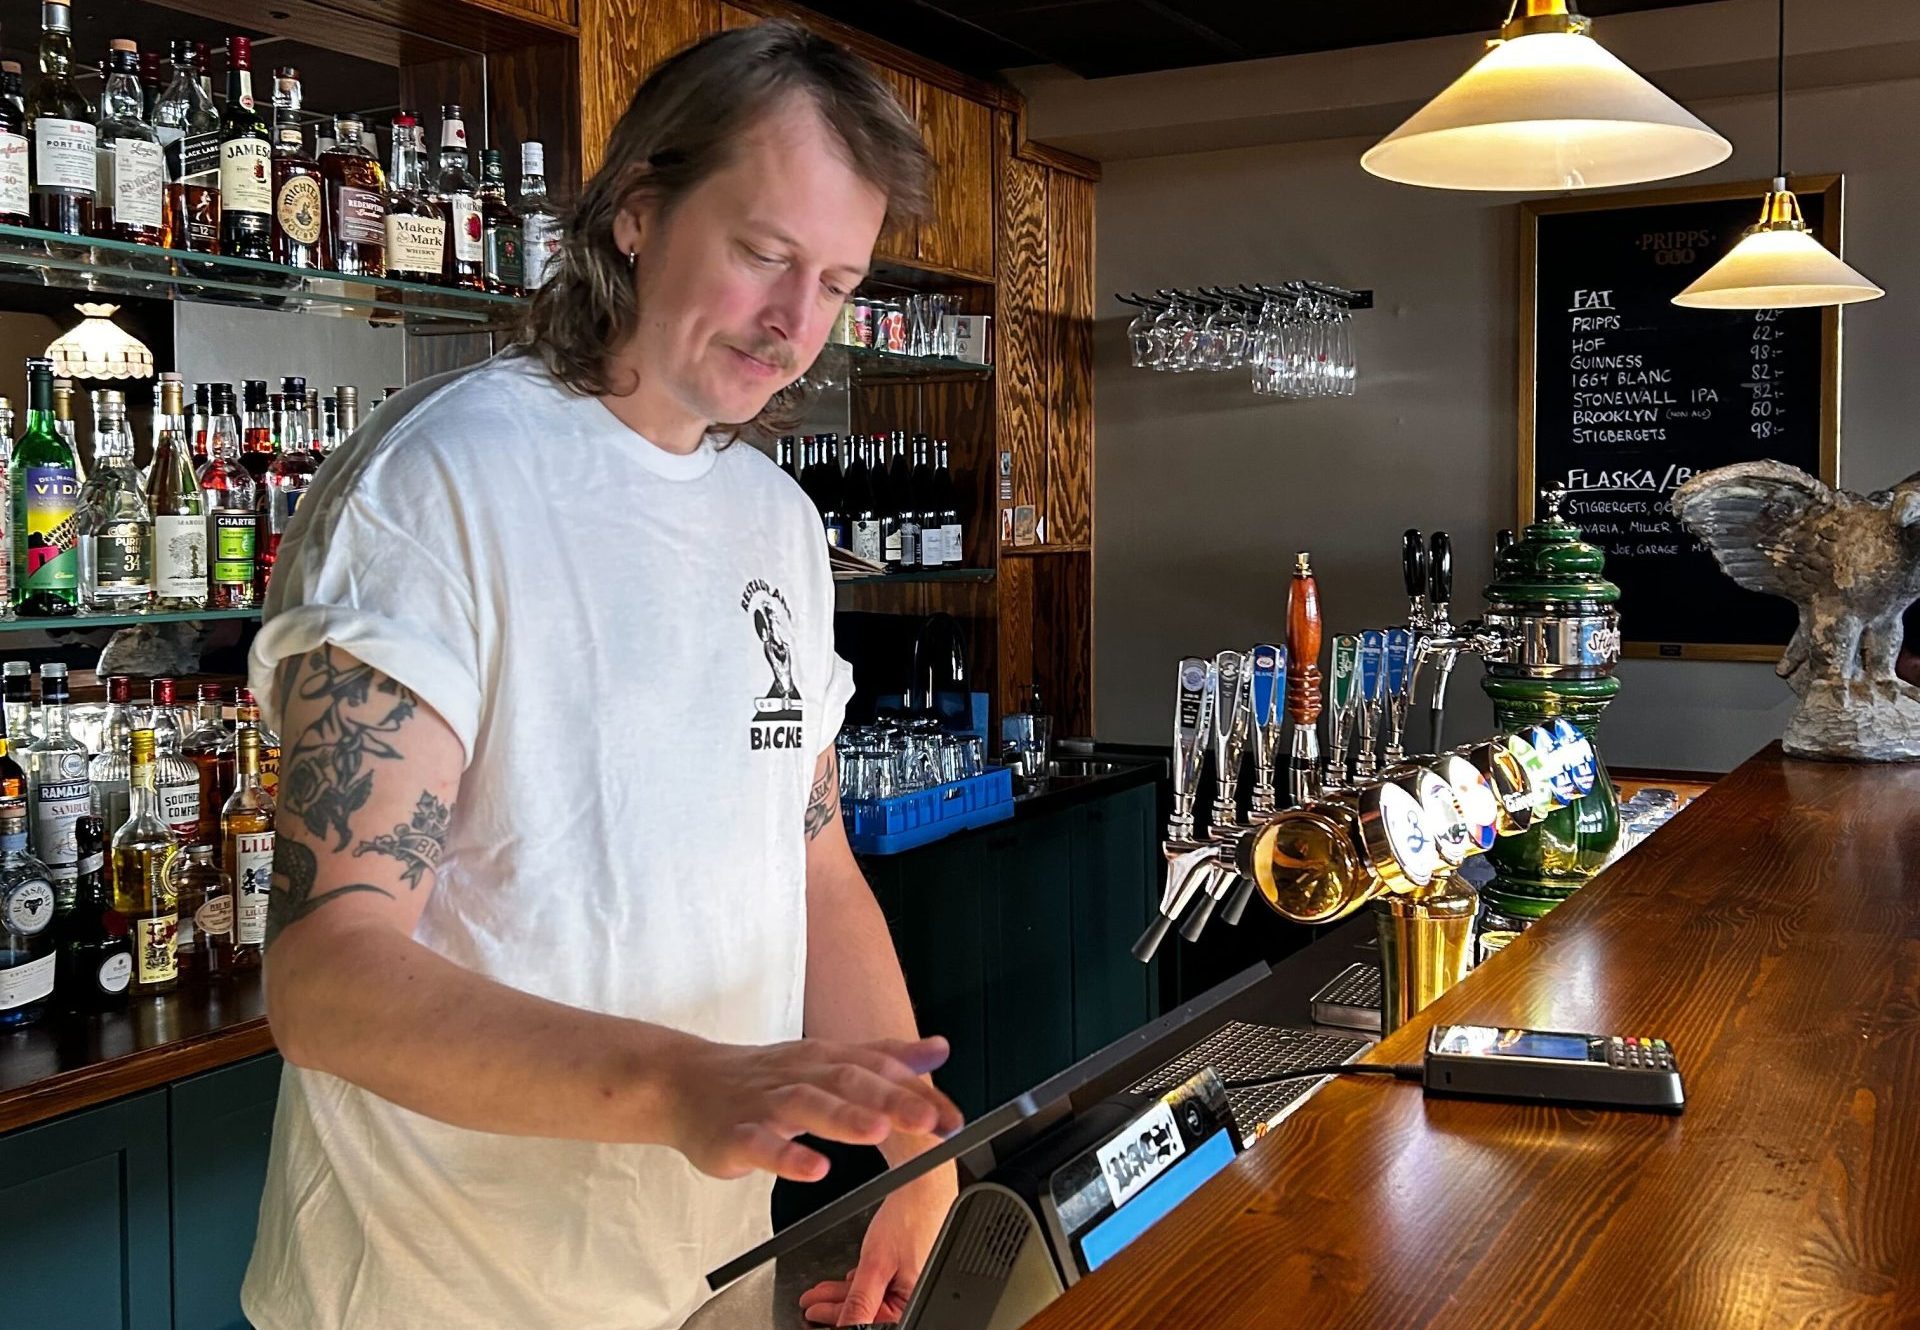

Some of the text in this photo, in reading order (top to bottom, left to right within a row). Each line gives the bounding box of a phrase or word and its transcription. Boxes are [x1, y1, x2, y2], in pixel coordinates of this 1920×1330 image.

[46, 140, 72, 148] PORT
[200, 226, 209, 236] 12
[397, 221, 443, 235] Maker's
[411, 234, 442, 247] Mark
[1641, 229, 1710, 250] PRIPPS
[1573, 290, 1613, 308] FAT
[1572, 315, 1621, 333] PRIPPS
[1572, 338, 1606, 353] HOF
[1570, 355, 1643, 370] GUINNESS
[1572, 372, 1609, 388] 1664
[1617, 368, 1672, 386] BLANC
[1573, 389, 1677, 408] STONEWALL
[1691, 388, 1719, 403] IPA
[1573, 408, 1659, 425] BROOKLYN
[1572, 428, 1667, 443] STIGBERGETS
[1629, 521, 1672, 534] MILLER
[1637, 545, 1679, 555] GARAGE
[124, 554, 141, 571] 34
